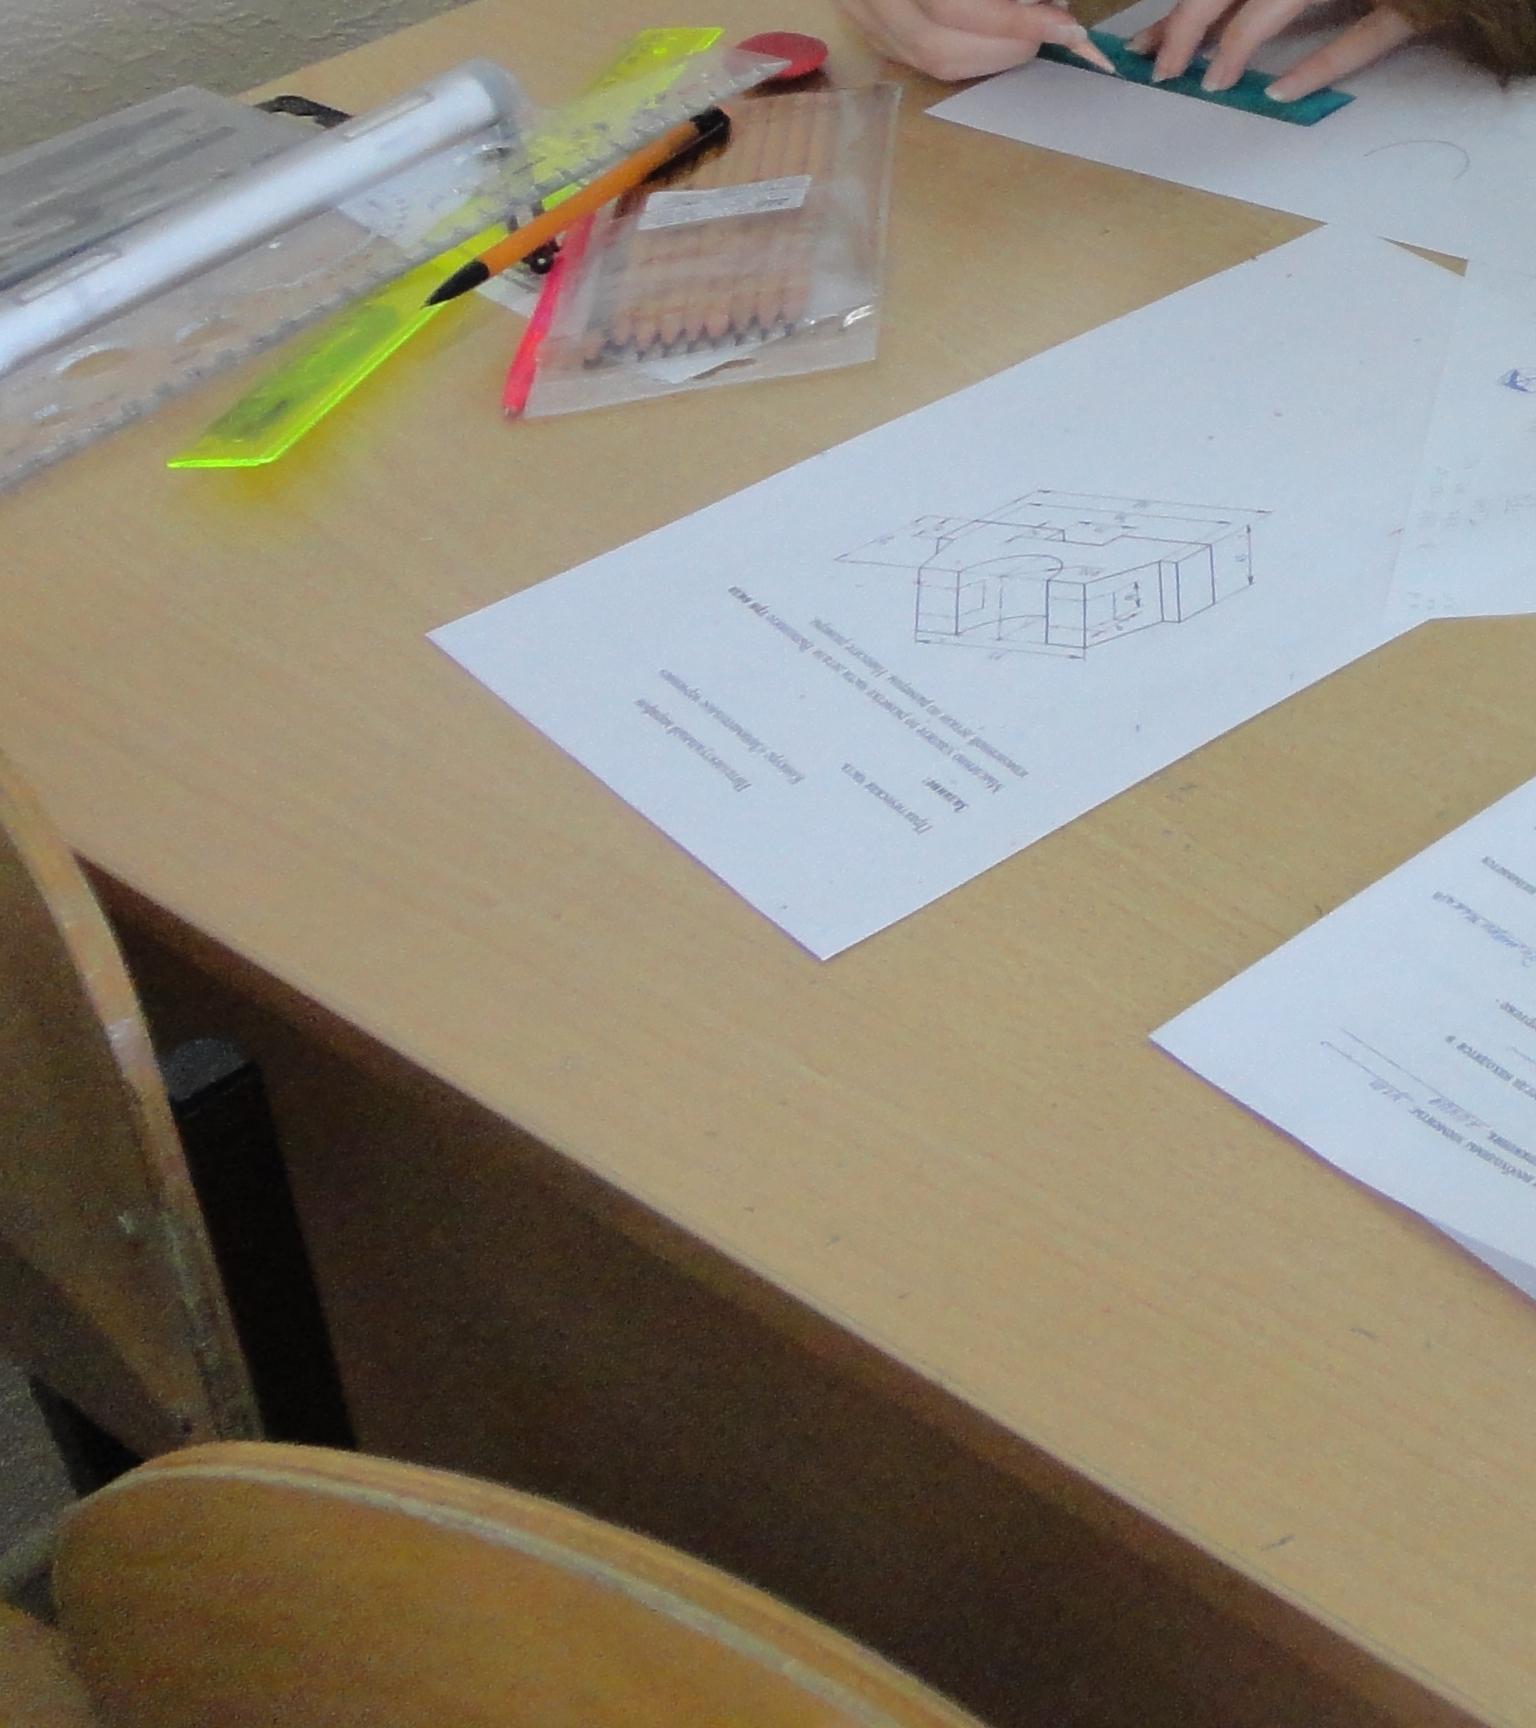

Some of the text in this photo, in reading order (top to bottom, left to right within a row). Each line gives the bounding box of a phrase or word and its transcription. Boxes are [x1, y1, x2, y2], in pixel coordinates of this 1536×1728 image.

[761, 749, 806, 785] Конкурс
[950, 753, 1006, 795] Мысленно
[837, 761, 934, 835] Практическая часть
[919, 776, 970, 814] Задание:
[1454, 1041, 1517, 1081] находится
